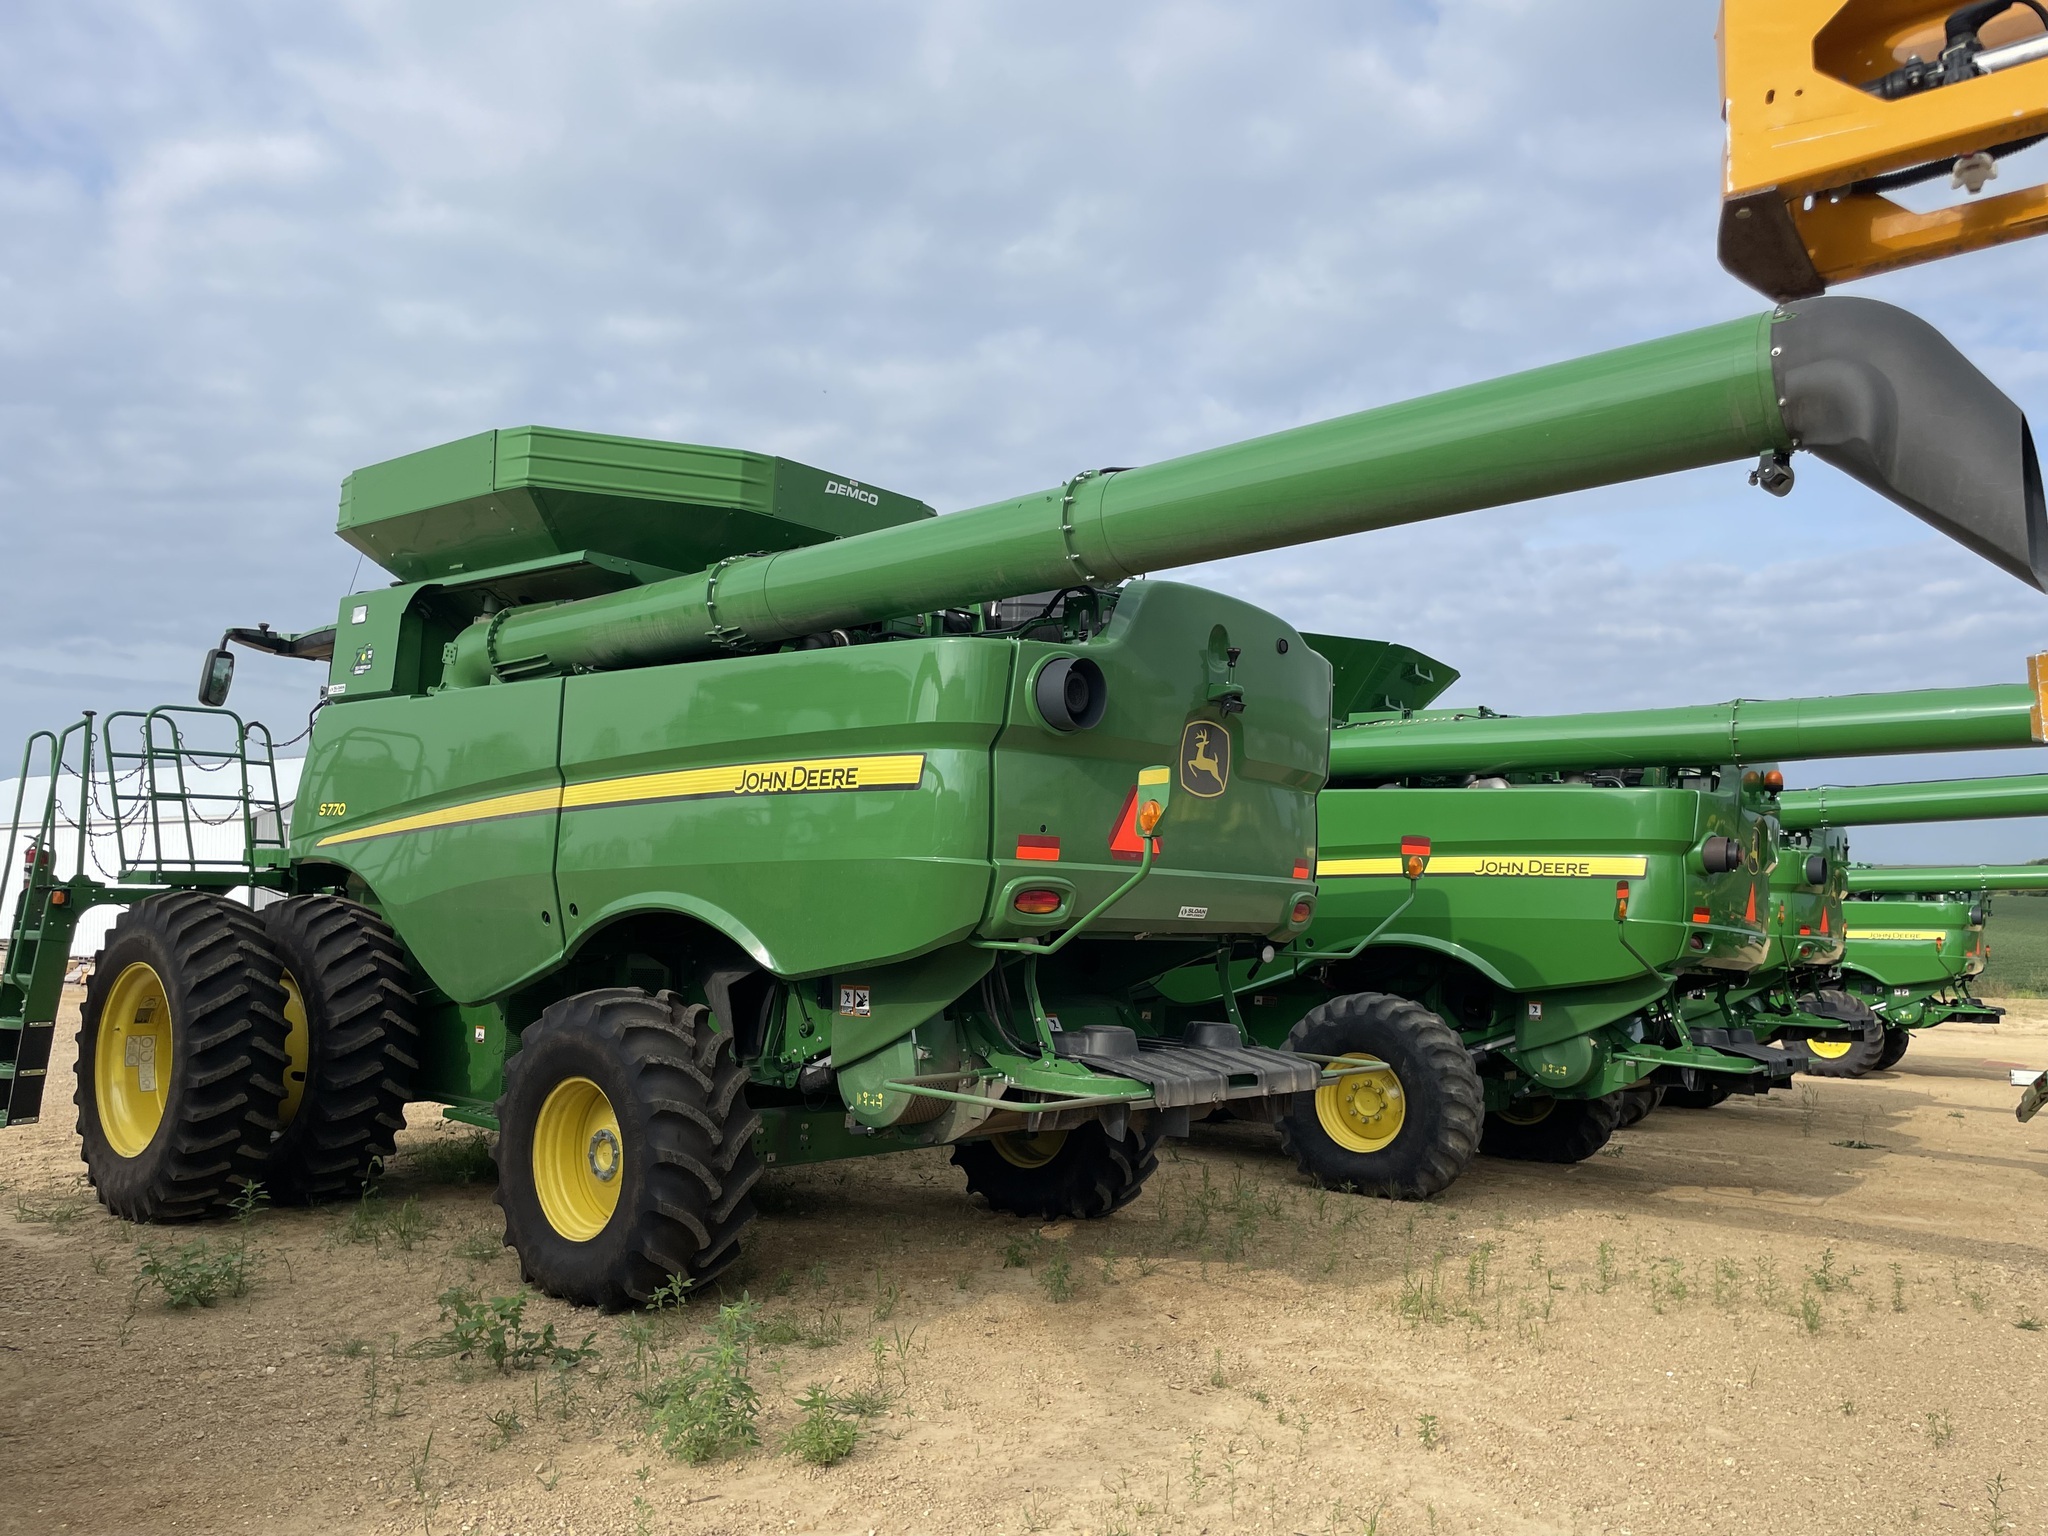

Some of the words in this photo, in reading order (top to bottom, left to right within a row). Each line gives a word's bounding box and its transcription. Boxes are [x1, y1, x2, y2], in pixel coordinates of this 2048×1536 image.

[824, 480, 879, 506] DEMCO
[735, 769, 787, 791] JOHN
[791, 766, 859, 788] DEERE
[319, 802, 347, 816] S770
[1475, 859, 1524, 873] JOHN
[1528, 860, 1590, 874] DEERE
